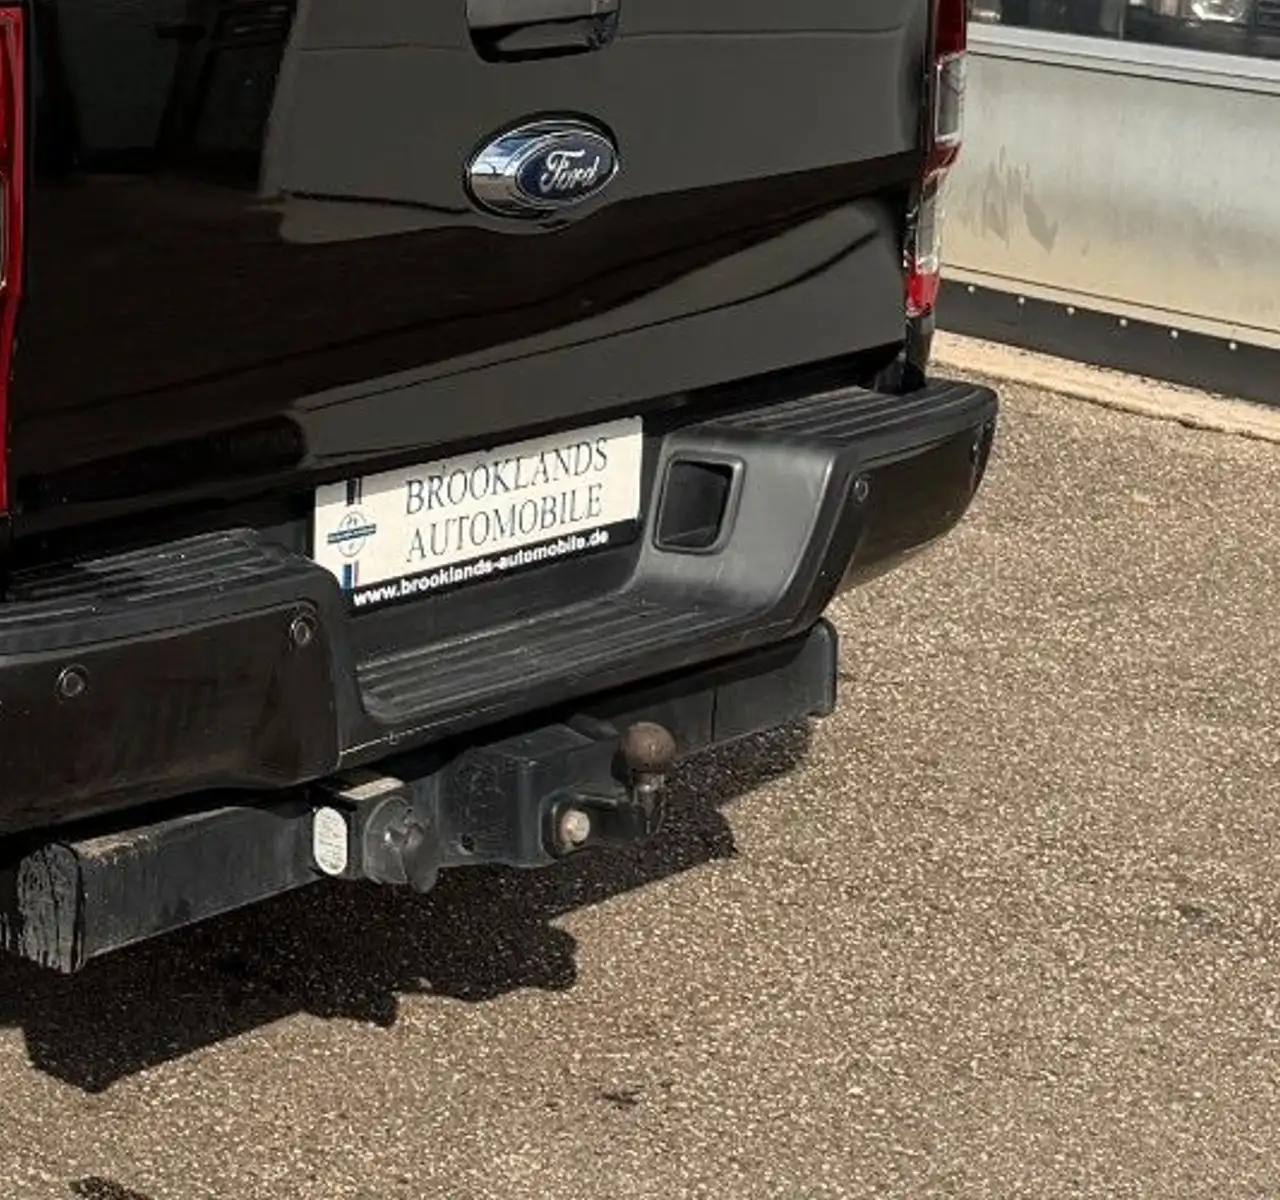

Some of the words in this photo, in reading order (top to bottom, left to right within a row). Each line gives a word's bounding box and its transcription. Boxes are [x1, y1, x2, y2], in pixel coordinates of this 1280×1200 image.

[540, 149, 600, 193] Ford
[406, 437, 609, 515] BROOKLANDS
[406, 483, 603, 563] AUTOMOBILE
[353, 528, 610, 607] www.brooklands-automobile.de
